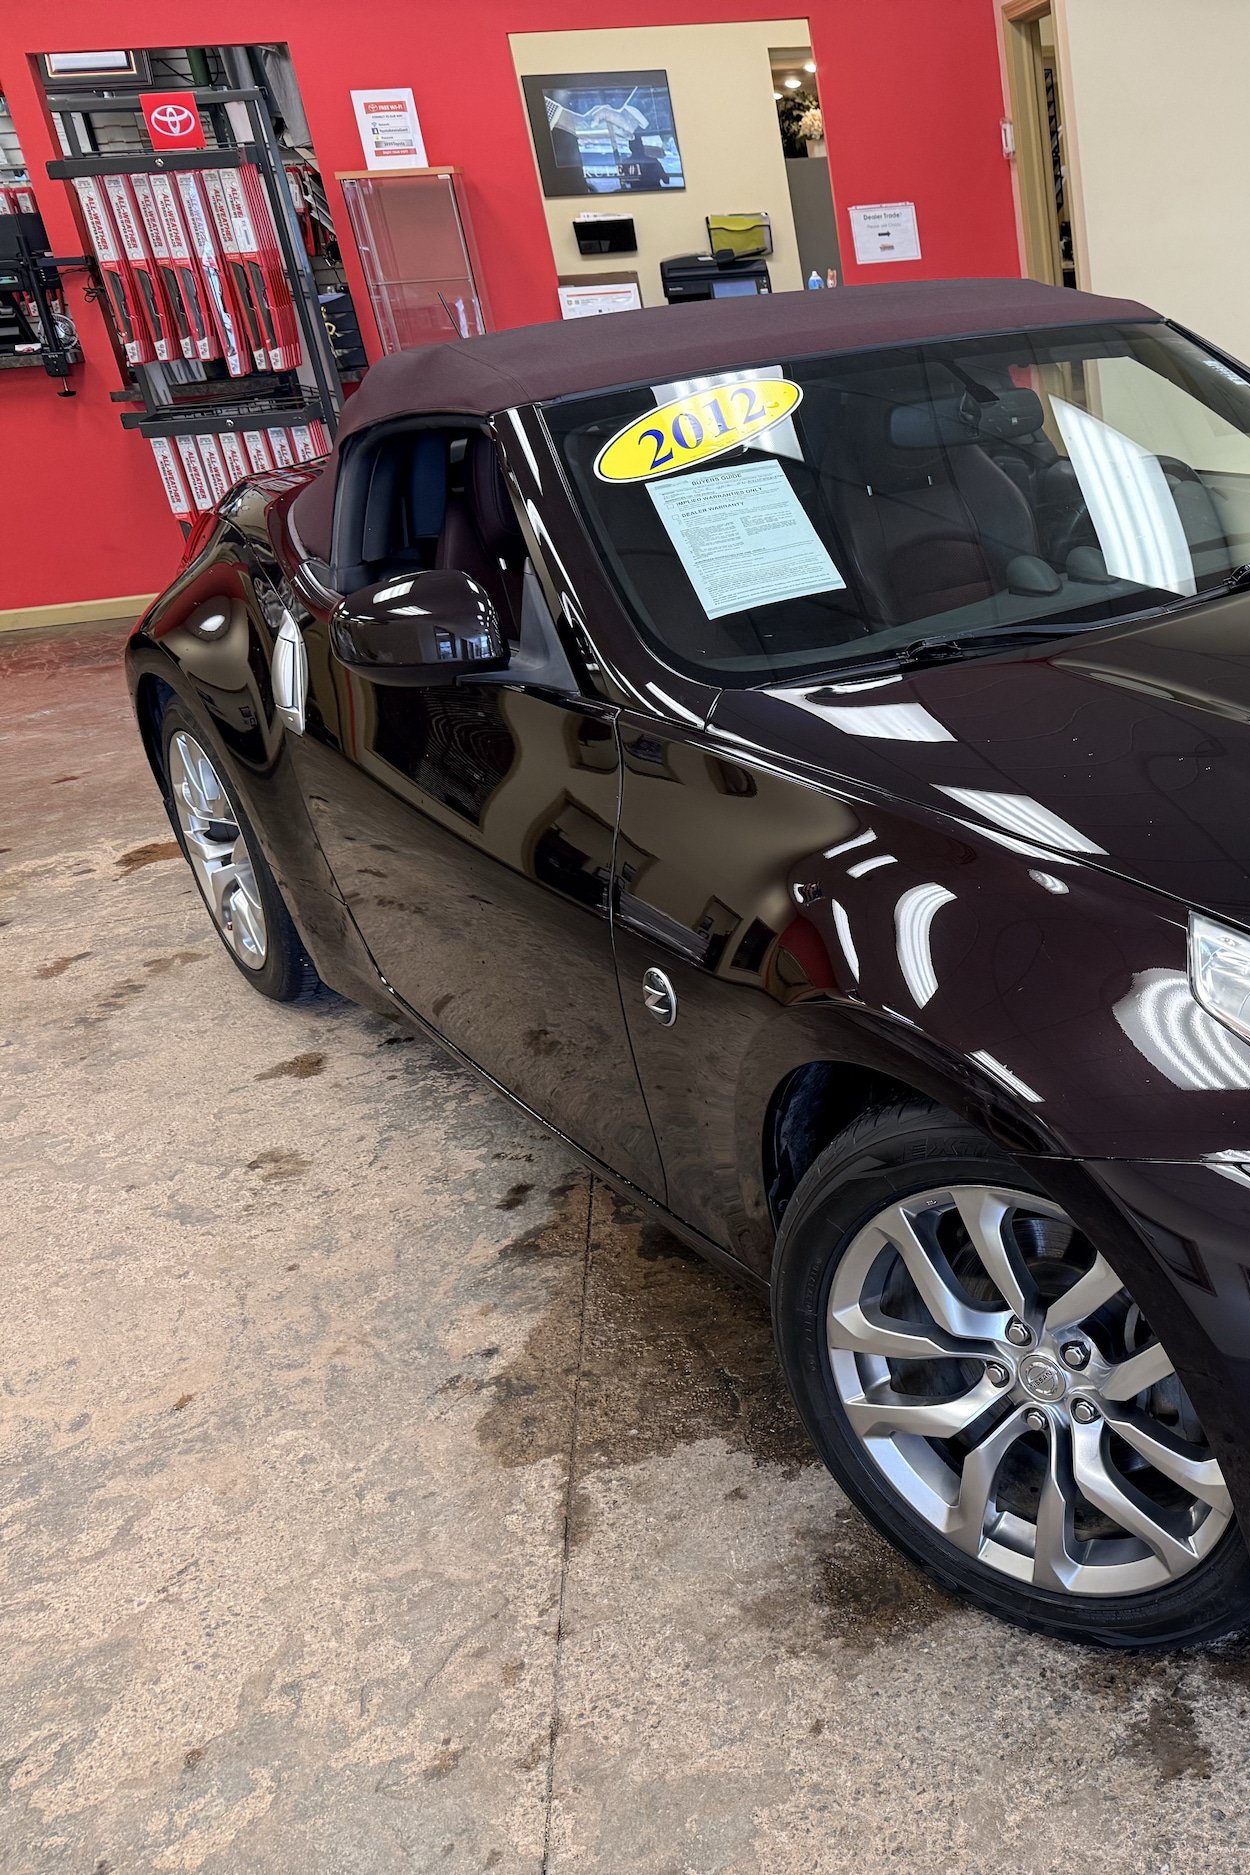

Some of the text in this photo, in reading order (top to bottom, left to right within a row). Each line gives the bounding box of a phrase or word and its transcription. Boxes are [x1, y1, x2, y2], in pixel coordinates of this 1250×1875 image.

[582, 164, 642, 178] RULE #1
[638, 388, 766, 470] 2012
[692, 476, 720, 486] BUYERS
[676, 497, 702, 506] IMPLIED
[703, 490, 744, 501] WARRANTIES
[681, 502, 744, 518] DEALER WARRANTY
[1030, 1370, 1053, 1387] NISSAN
